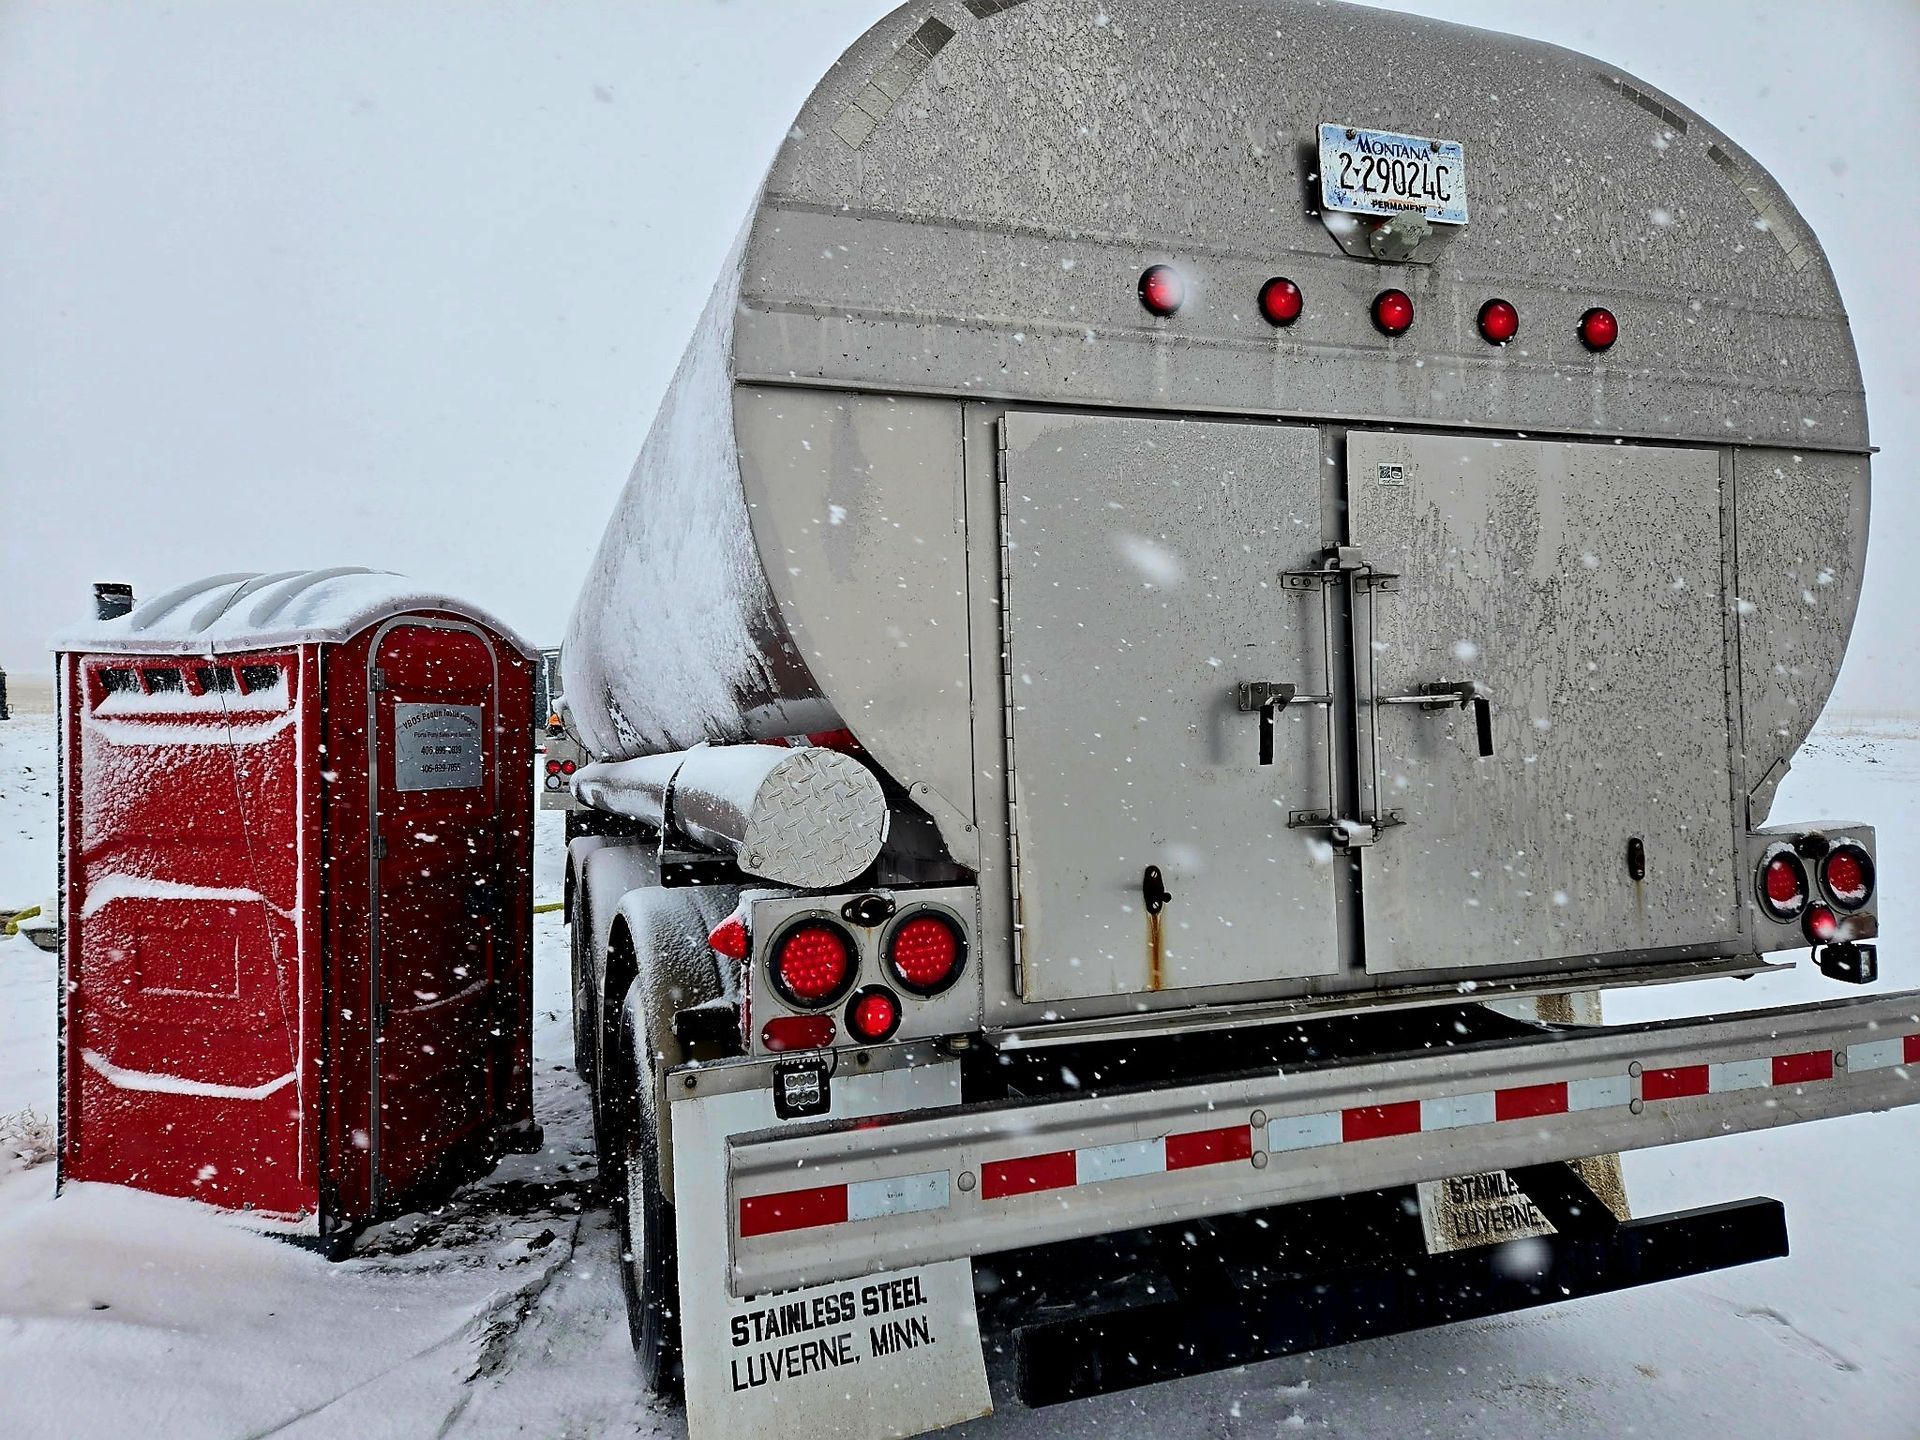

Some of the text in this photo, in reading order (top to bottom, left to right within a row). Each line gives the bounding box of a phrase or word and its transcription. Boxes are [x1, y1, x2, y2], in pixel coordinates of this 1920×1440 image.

[1355, 134, 1431, 162] MONTANA
[1371, 200, 1428, 214] PERMANENT
[730, 1291, 856, 1348] STAINLESS
[861, 1275, 928, 1317] STEEL
[730, 1315, 936, 1392] LUVERNE, MINN.
